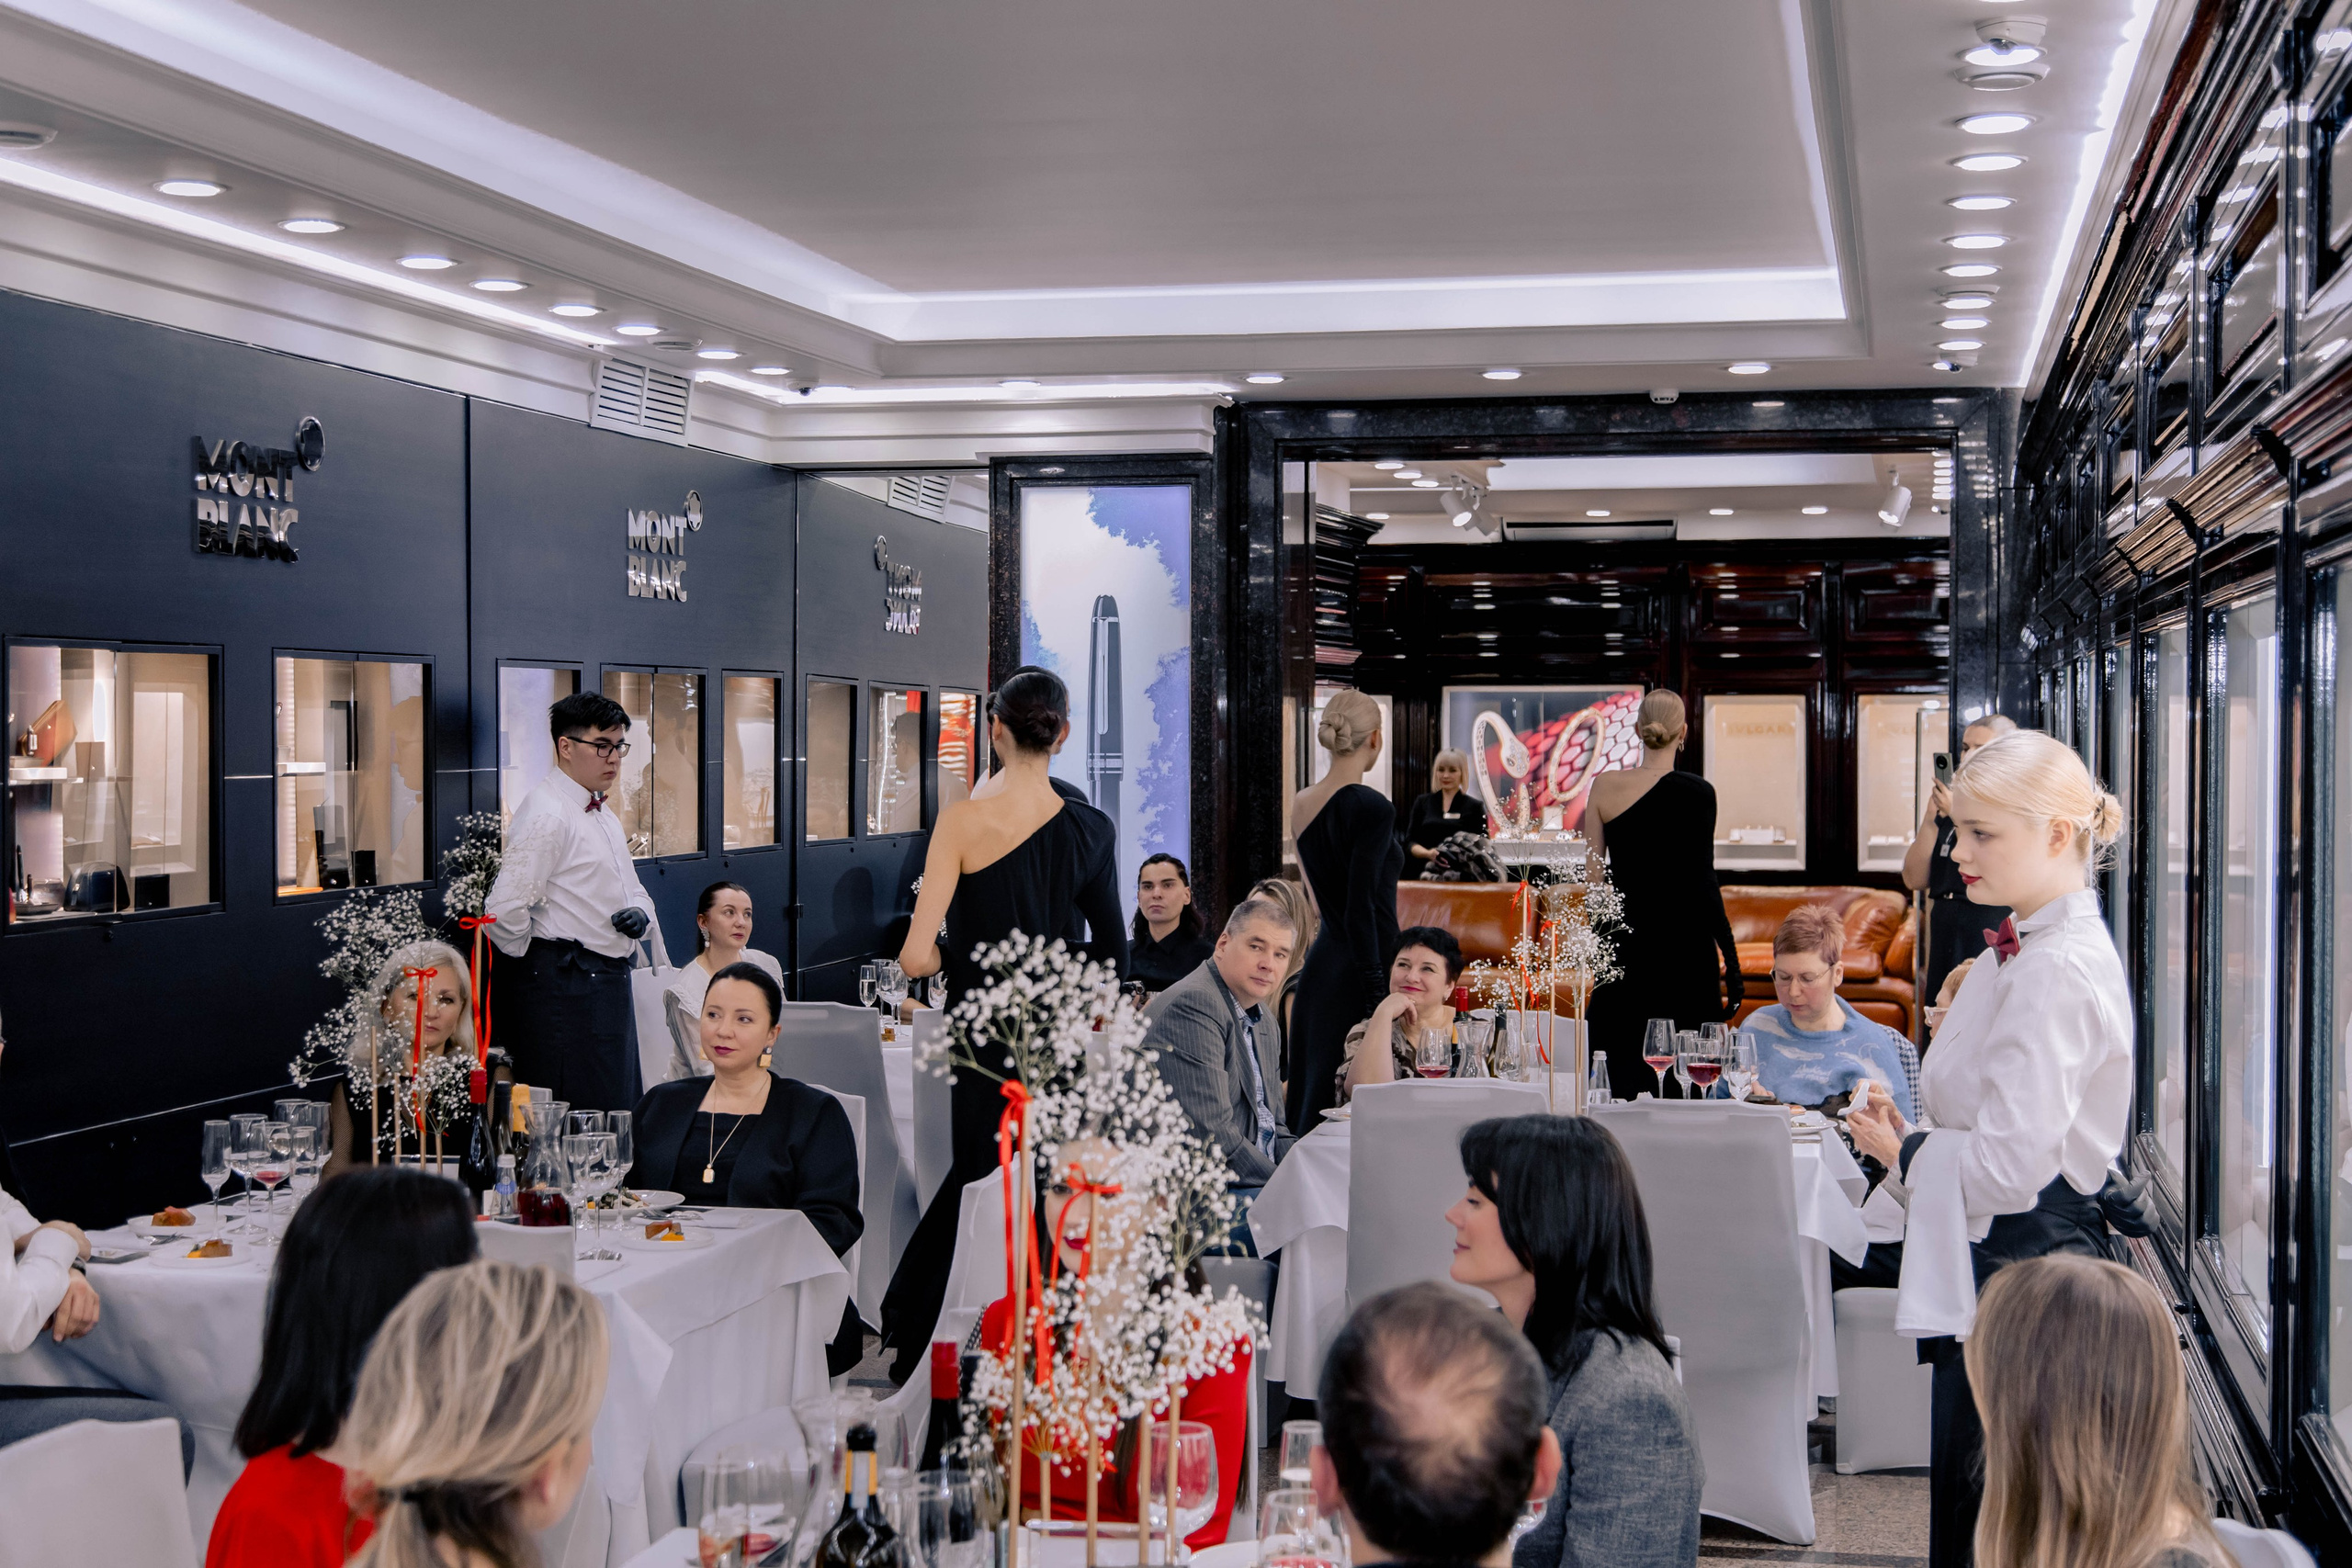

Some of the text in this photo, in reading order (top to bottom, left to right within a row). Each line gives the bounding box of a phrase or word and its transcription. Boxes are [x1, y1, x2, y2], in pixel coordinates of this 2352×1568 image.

[191, 435, 298, 502] MONT
[192, 497, 300, 563] BLANC
[627, 508, 687, 556] MONT
[627, 555, 687, 603] BLANC
